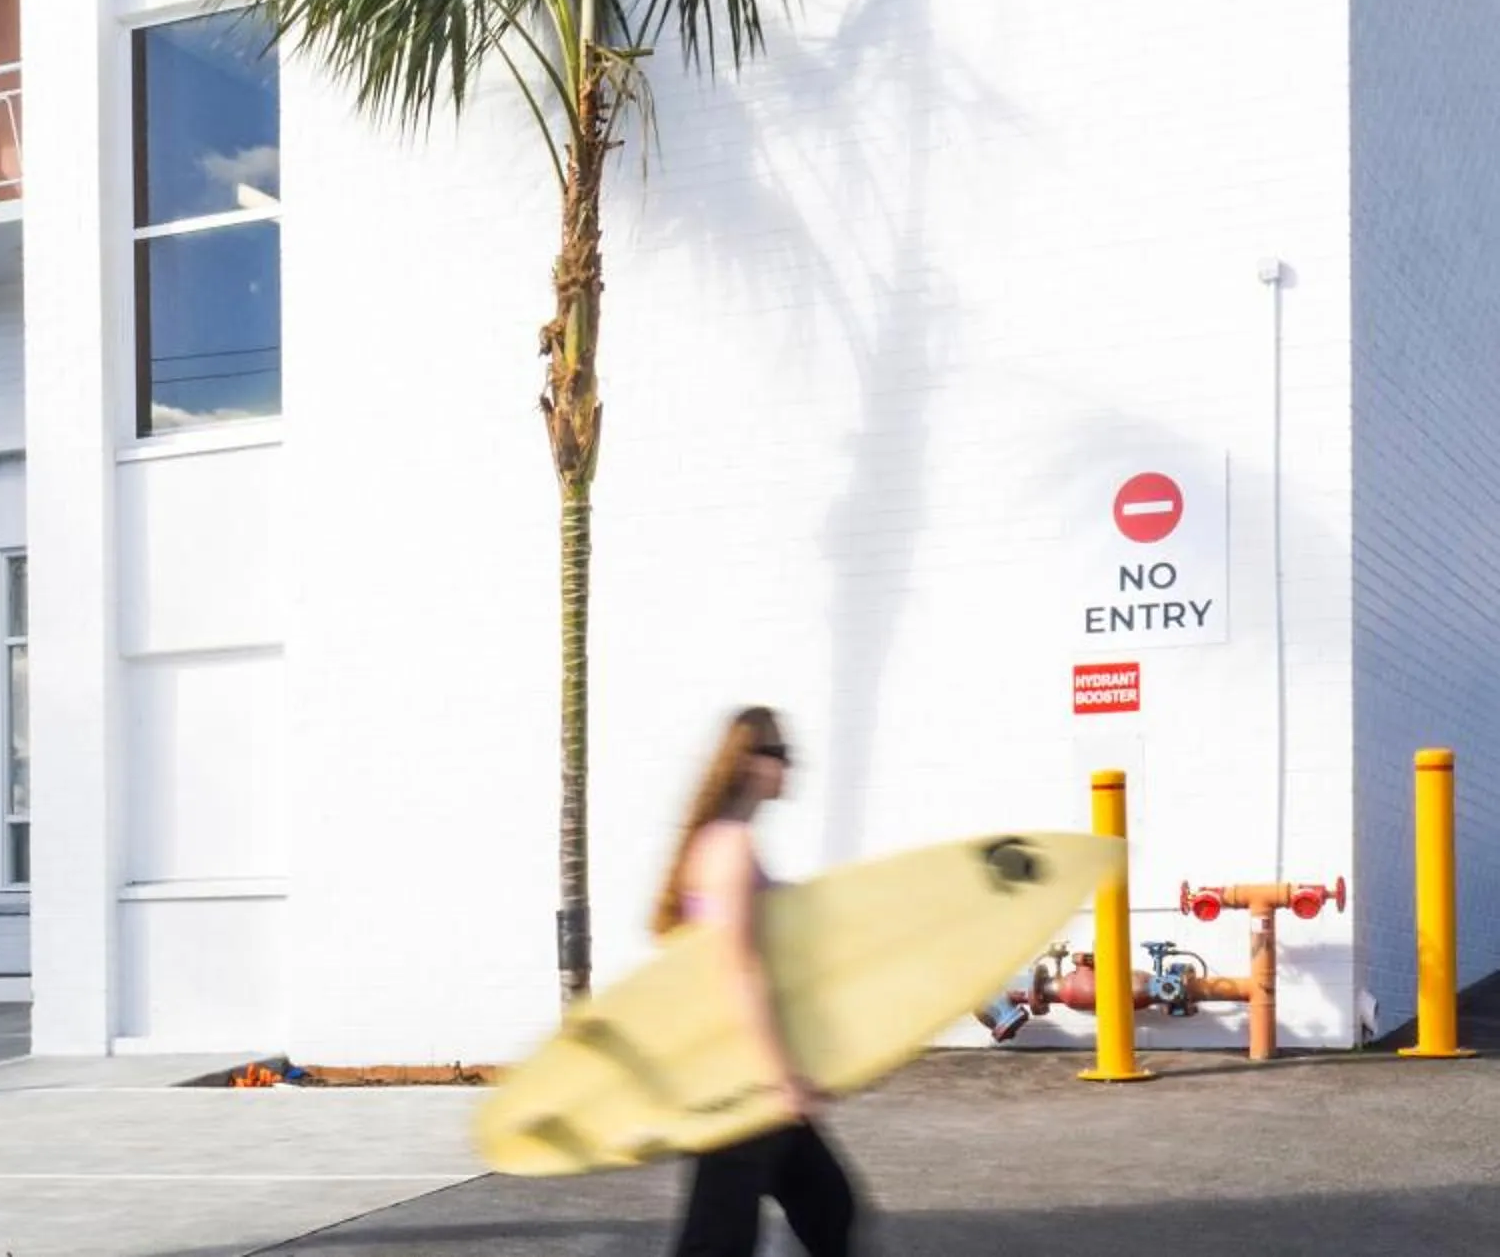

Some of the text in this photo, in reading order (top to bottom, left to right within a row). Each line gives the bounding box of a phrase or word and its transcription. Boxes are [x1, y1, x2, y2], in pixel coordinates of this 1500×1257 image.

[1118, 561, 1178, 592] NO
[1084, 598, 1213, 634] ENTRY
[1074, 670, 1138, 689] HYDRANT
[1074, 688, 1138, 705] BOOSTER
